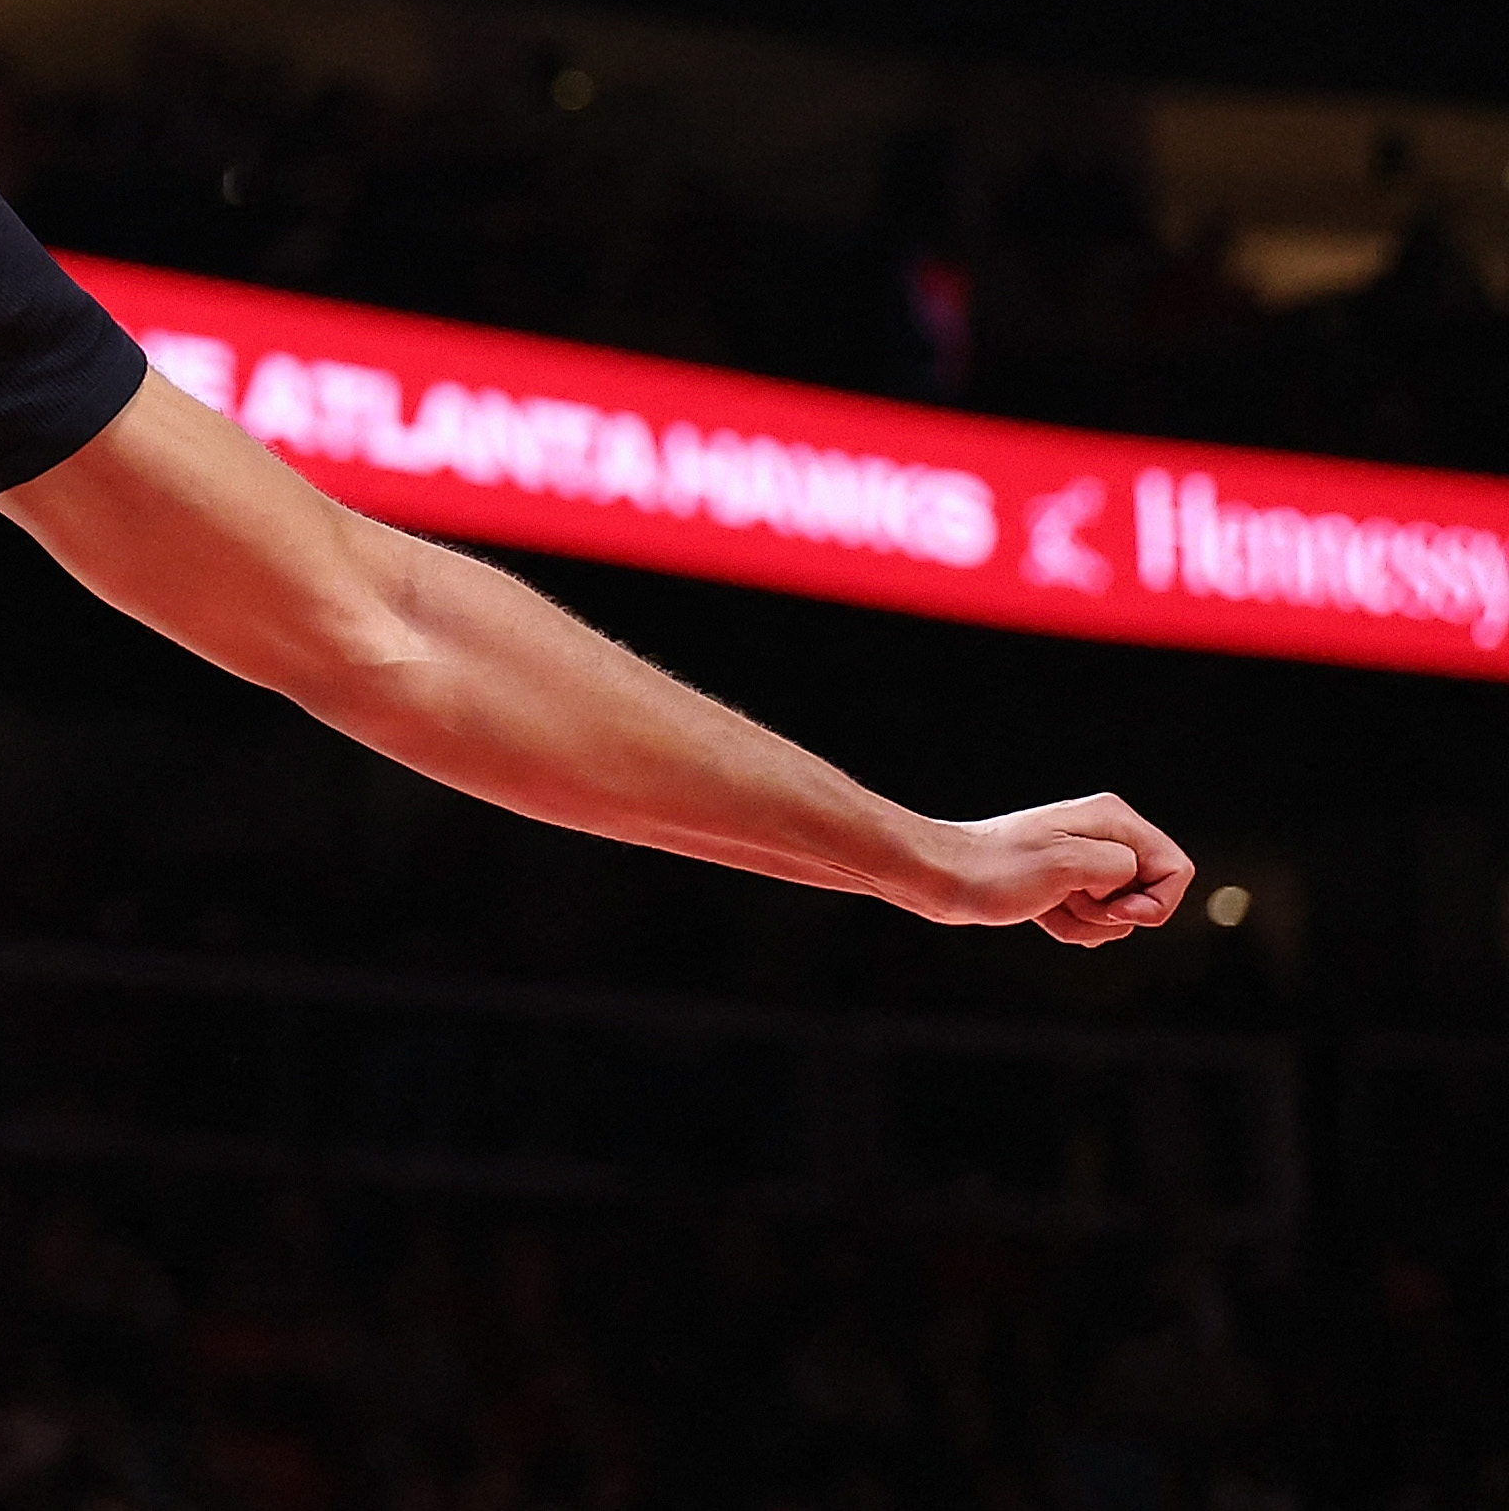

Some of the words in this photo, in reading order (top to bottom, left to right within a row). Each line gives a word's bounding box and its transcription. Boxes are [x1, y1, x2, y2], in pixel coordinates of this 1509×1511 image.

[241, 351, 657, 513] ATLANTA
[659, 421, 996, 569] HAWKS
[1132, 466, 1509, 650] Hennessy
